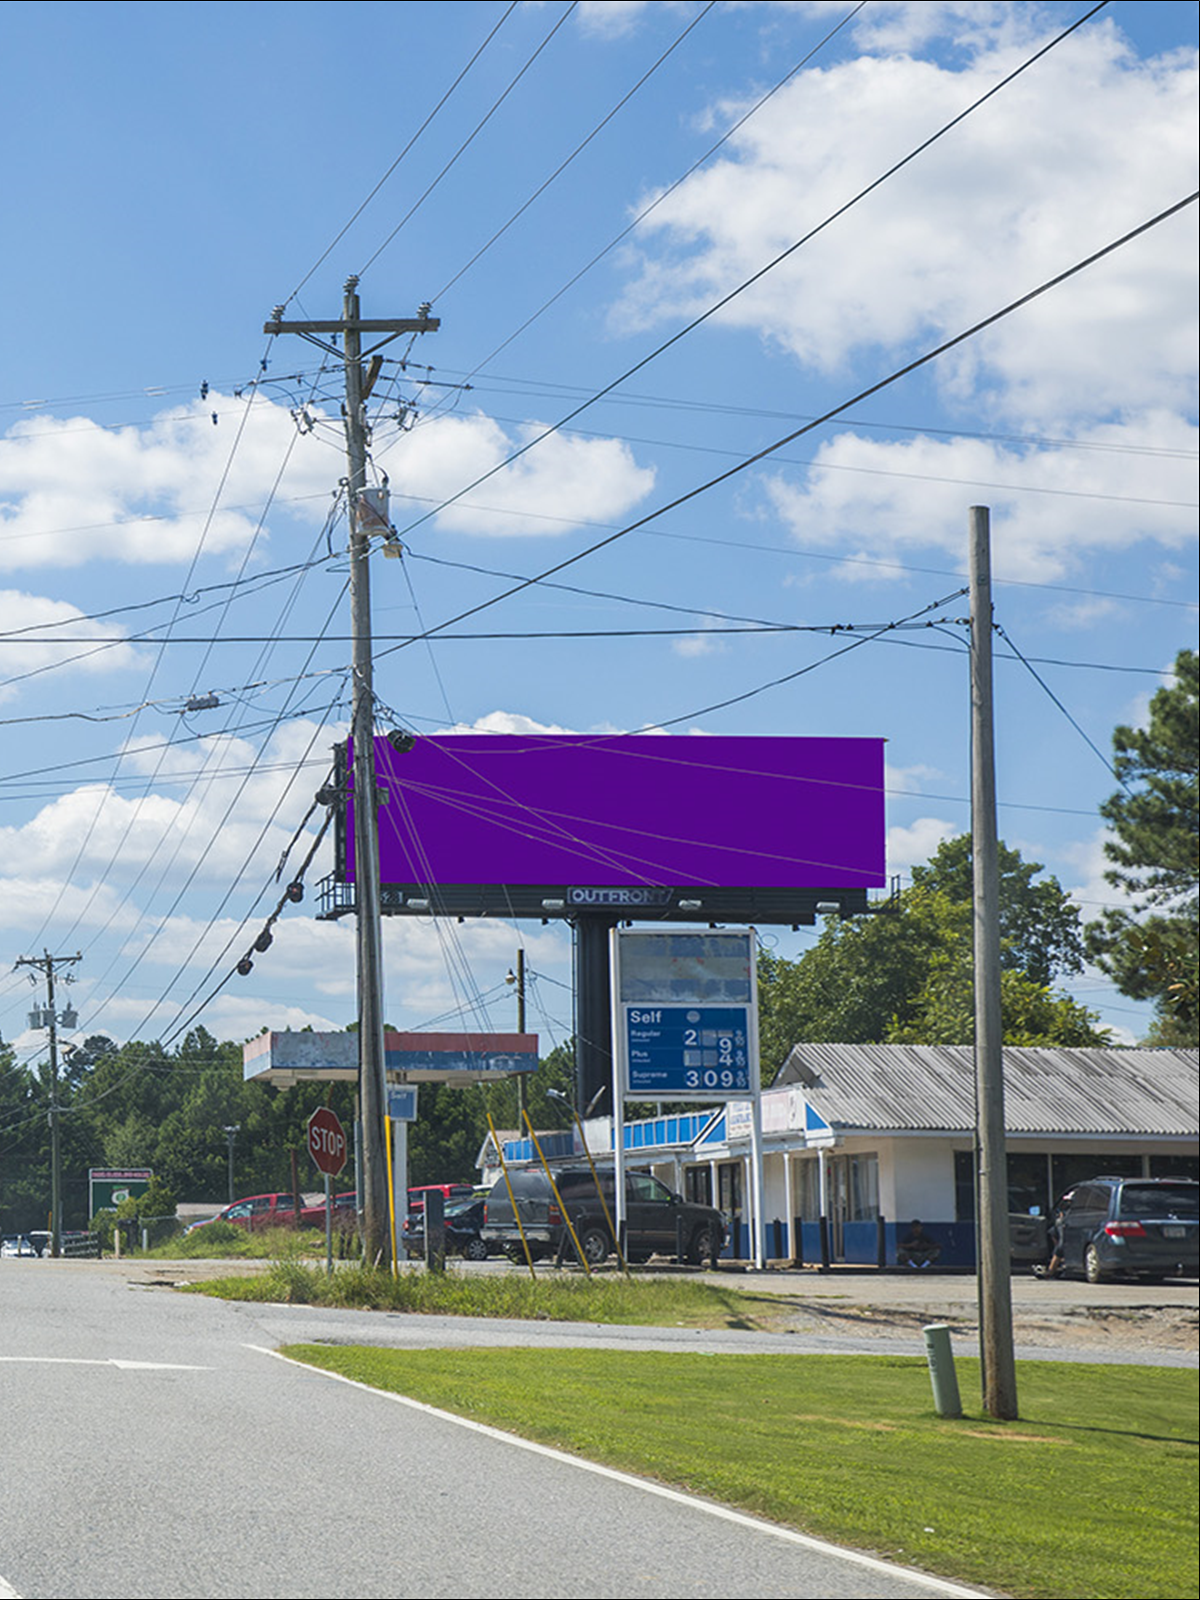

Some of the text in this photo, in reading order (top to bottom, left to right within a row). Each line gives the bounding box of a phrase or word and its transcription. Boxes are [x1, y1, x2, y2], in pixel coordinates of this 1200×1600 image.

[630, 1010, 662, 1023] Self
[630, 1030, 661, 1038] Regular
[684, 1029, 697, 1046] 2
[719, 1037, 732, 1054] 9
[719, 1053, 733, 1066] 4
[632, 1070, 668, 1079] Supreme
[311, 1126, 344, 1157] STOP
